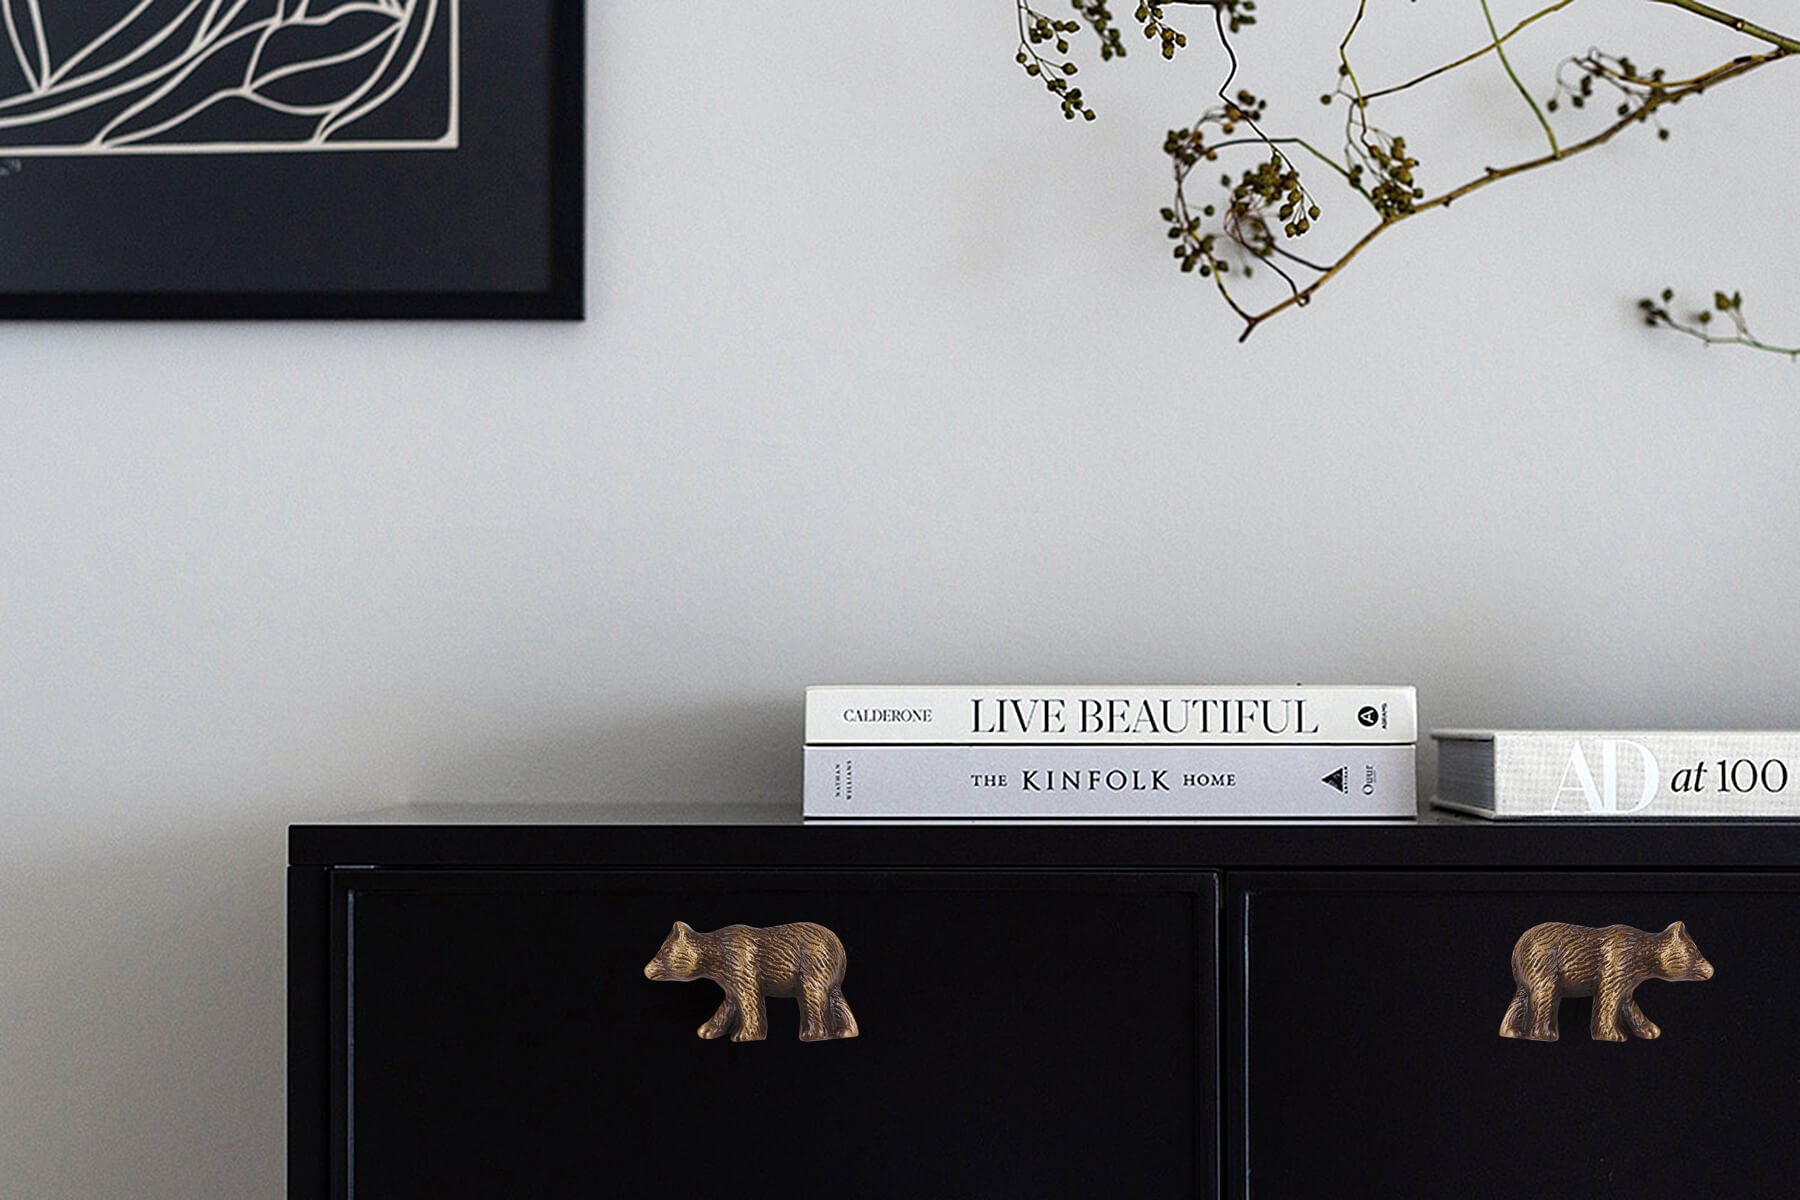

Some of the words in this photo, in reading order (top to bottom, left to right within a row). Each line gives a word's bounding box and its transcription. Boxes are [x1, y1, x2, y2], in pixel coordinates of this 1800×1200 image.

[843, 708, 933, 723] CALDERONE
[970, 698, 1066, 733] LIVE
[1078, 698, 1319, 735] BEAUTIFUL
[970, 774, 1008, 787] THE
[1022, 769, 1171, 792] KINFOLK
[1183, 773, 1237, 787] HOME
[1543, 739, 1660, 815] AD
[1670, 761, 1708, 793] at
[1717, 758, 1788, 793] 100
